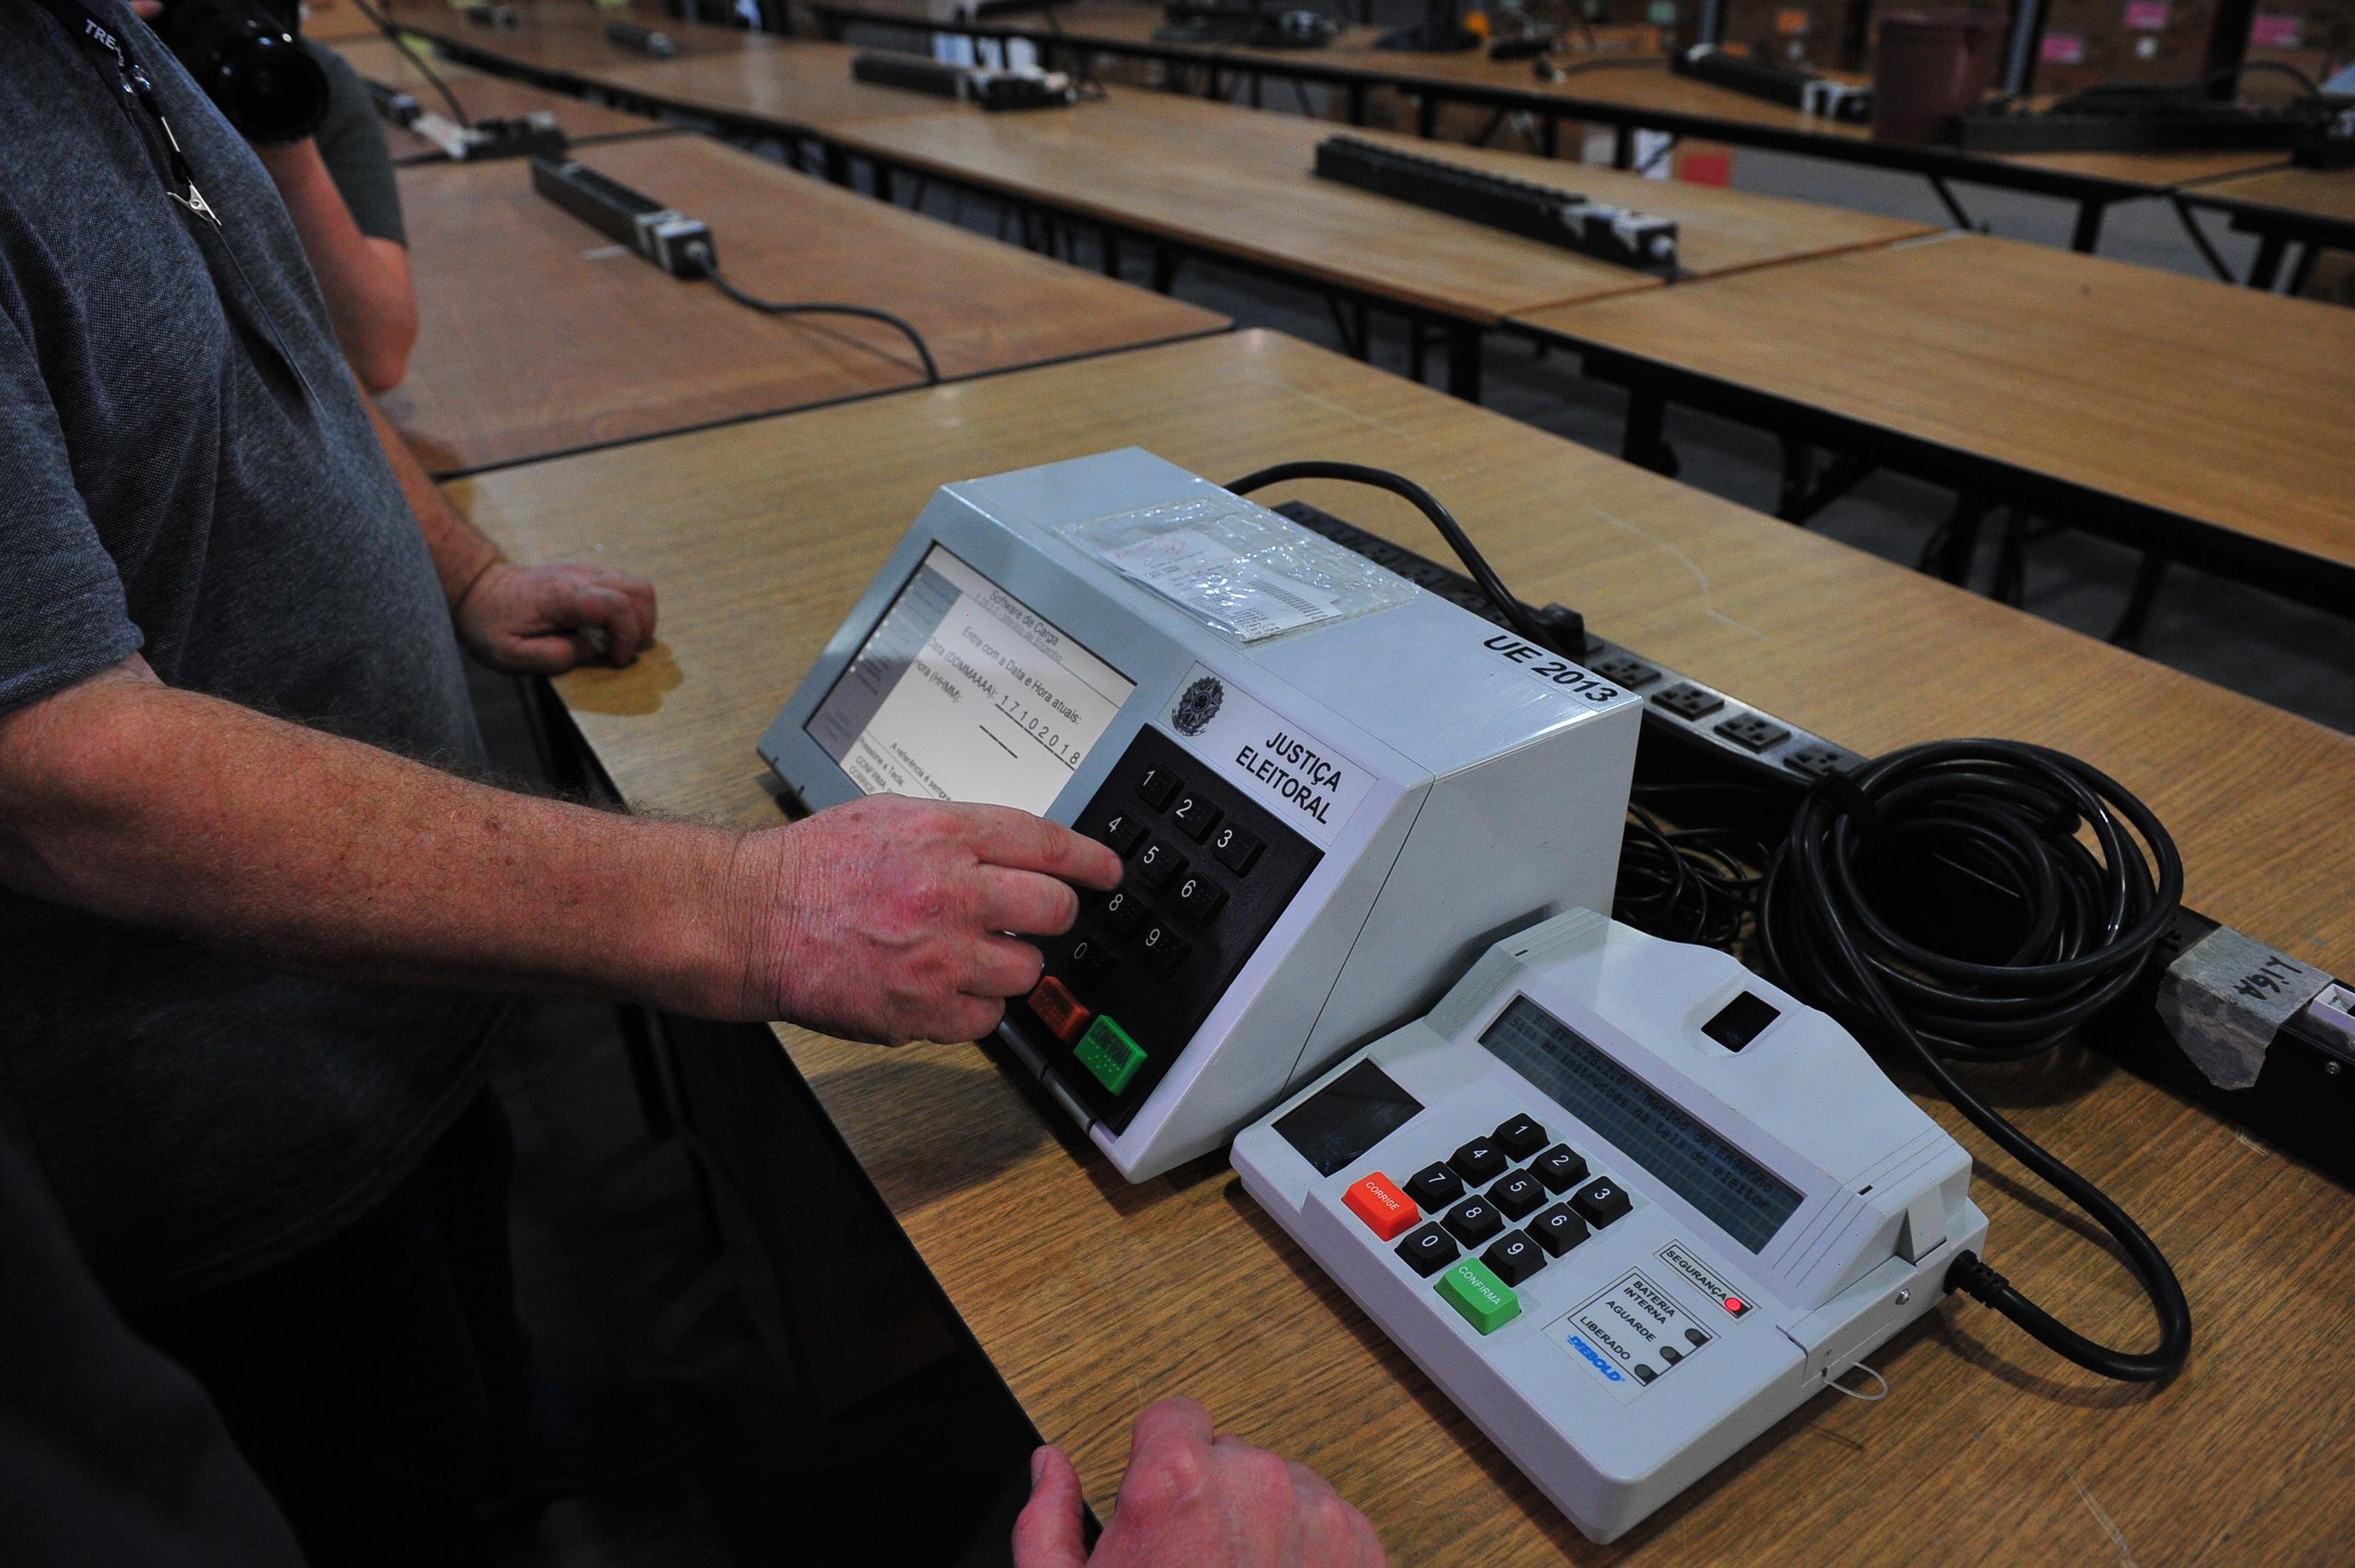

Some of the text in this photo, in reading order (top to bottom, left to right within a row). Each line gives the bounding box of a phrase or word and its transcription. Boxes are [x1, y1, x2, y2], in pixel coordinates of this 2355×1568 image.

[990, 590, 1023, 620] Software
[1022, 615, 1035, 628] de
[1034, 622, 1060, 646] Carga
[928, 637, 946, 657] Data
[962, 626, 1082, 725] Entre com a Data e Hora atuais:
[1484, 635, 1619, 703] UE 2013
[1266, 731, 1343, 793] JUSTIÇA
[1142, 769, 1155, 786] 1
[1234, 745, 1331, 825] ELEITORAL
[1175, 799, 1192, 818] 2
[1109, 817, 1121, 834] 4
[1217, 829, 1233, 848] 3
[1143, 845, 1160, 864] 5
[1181, 879, 1197, 898] 6
[1109, 893, 1124, 911] 8
[1145, 928, 1160, 947] 9
[1073, 942, 1087, 960] 0
[1516, 1126, 1528, 1135] 1
[1473, 1149, 1488, 1158] 4
[1552, 1155, 1570, 1166] 2
[1691, 1128, 1715, 1150] de
[1714, 1146, 1776, 1194] Engenho
[1651, 1121, 1689, 1152] tela
[1687, 1146, 1711, 1168] do
[1712, 1165, 1772, 1214] eleitor
[1428, 1172, 1446, 1183] 7
[1510, 1180, 1527, 1192] 5
[1365, 1181, 1400, 1211] CORRIGE
[1594, 1188, 1611, 1200] 3
[1465, 1206, 1482, 1218] 8
[1551, 1214, 1567, 1226] 6
[1422, 1235, 1439, 1247] 0
[1507, 1243, 1524, 1255] 9
[1666, 1249, 1728, 1302] SEGURANÇA
[1459, 1266, 1501, 1305] CONFIRMA
[1623, 1287, 1667, 1325] INTERNA
[1632, 1280, 1676, 1318] BATERIA
[1605, 1299, 1658, 1343] AGUARDE
[1579, 1316, 1632, 1361] LIBERADO
[1567, 1334, 1623, 1382] DIEBOLD
